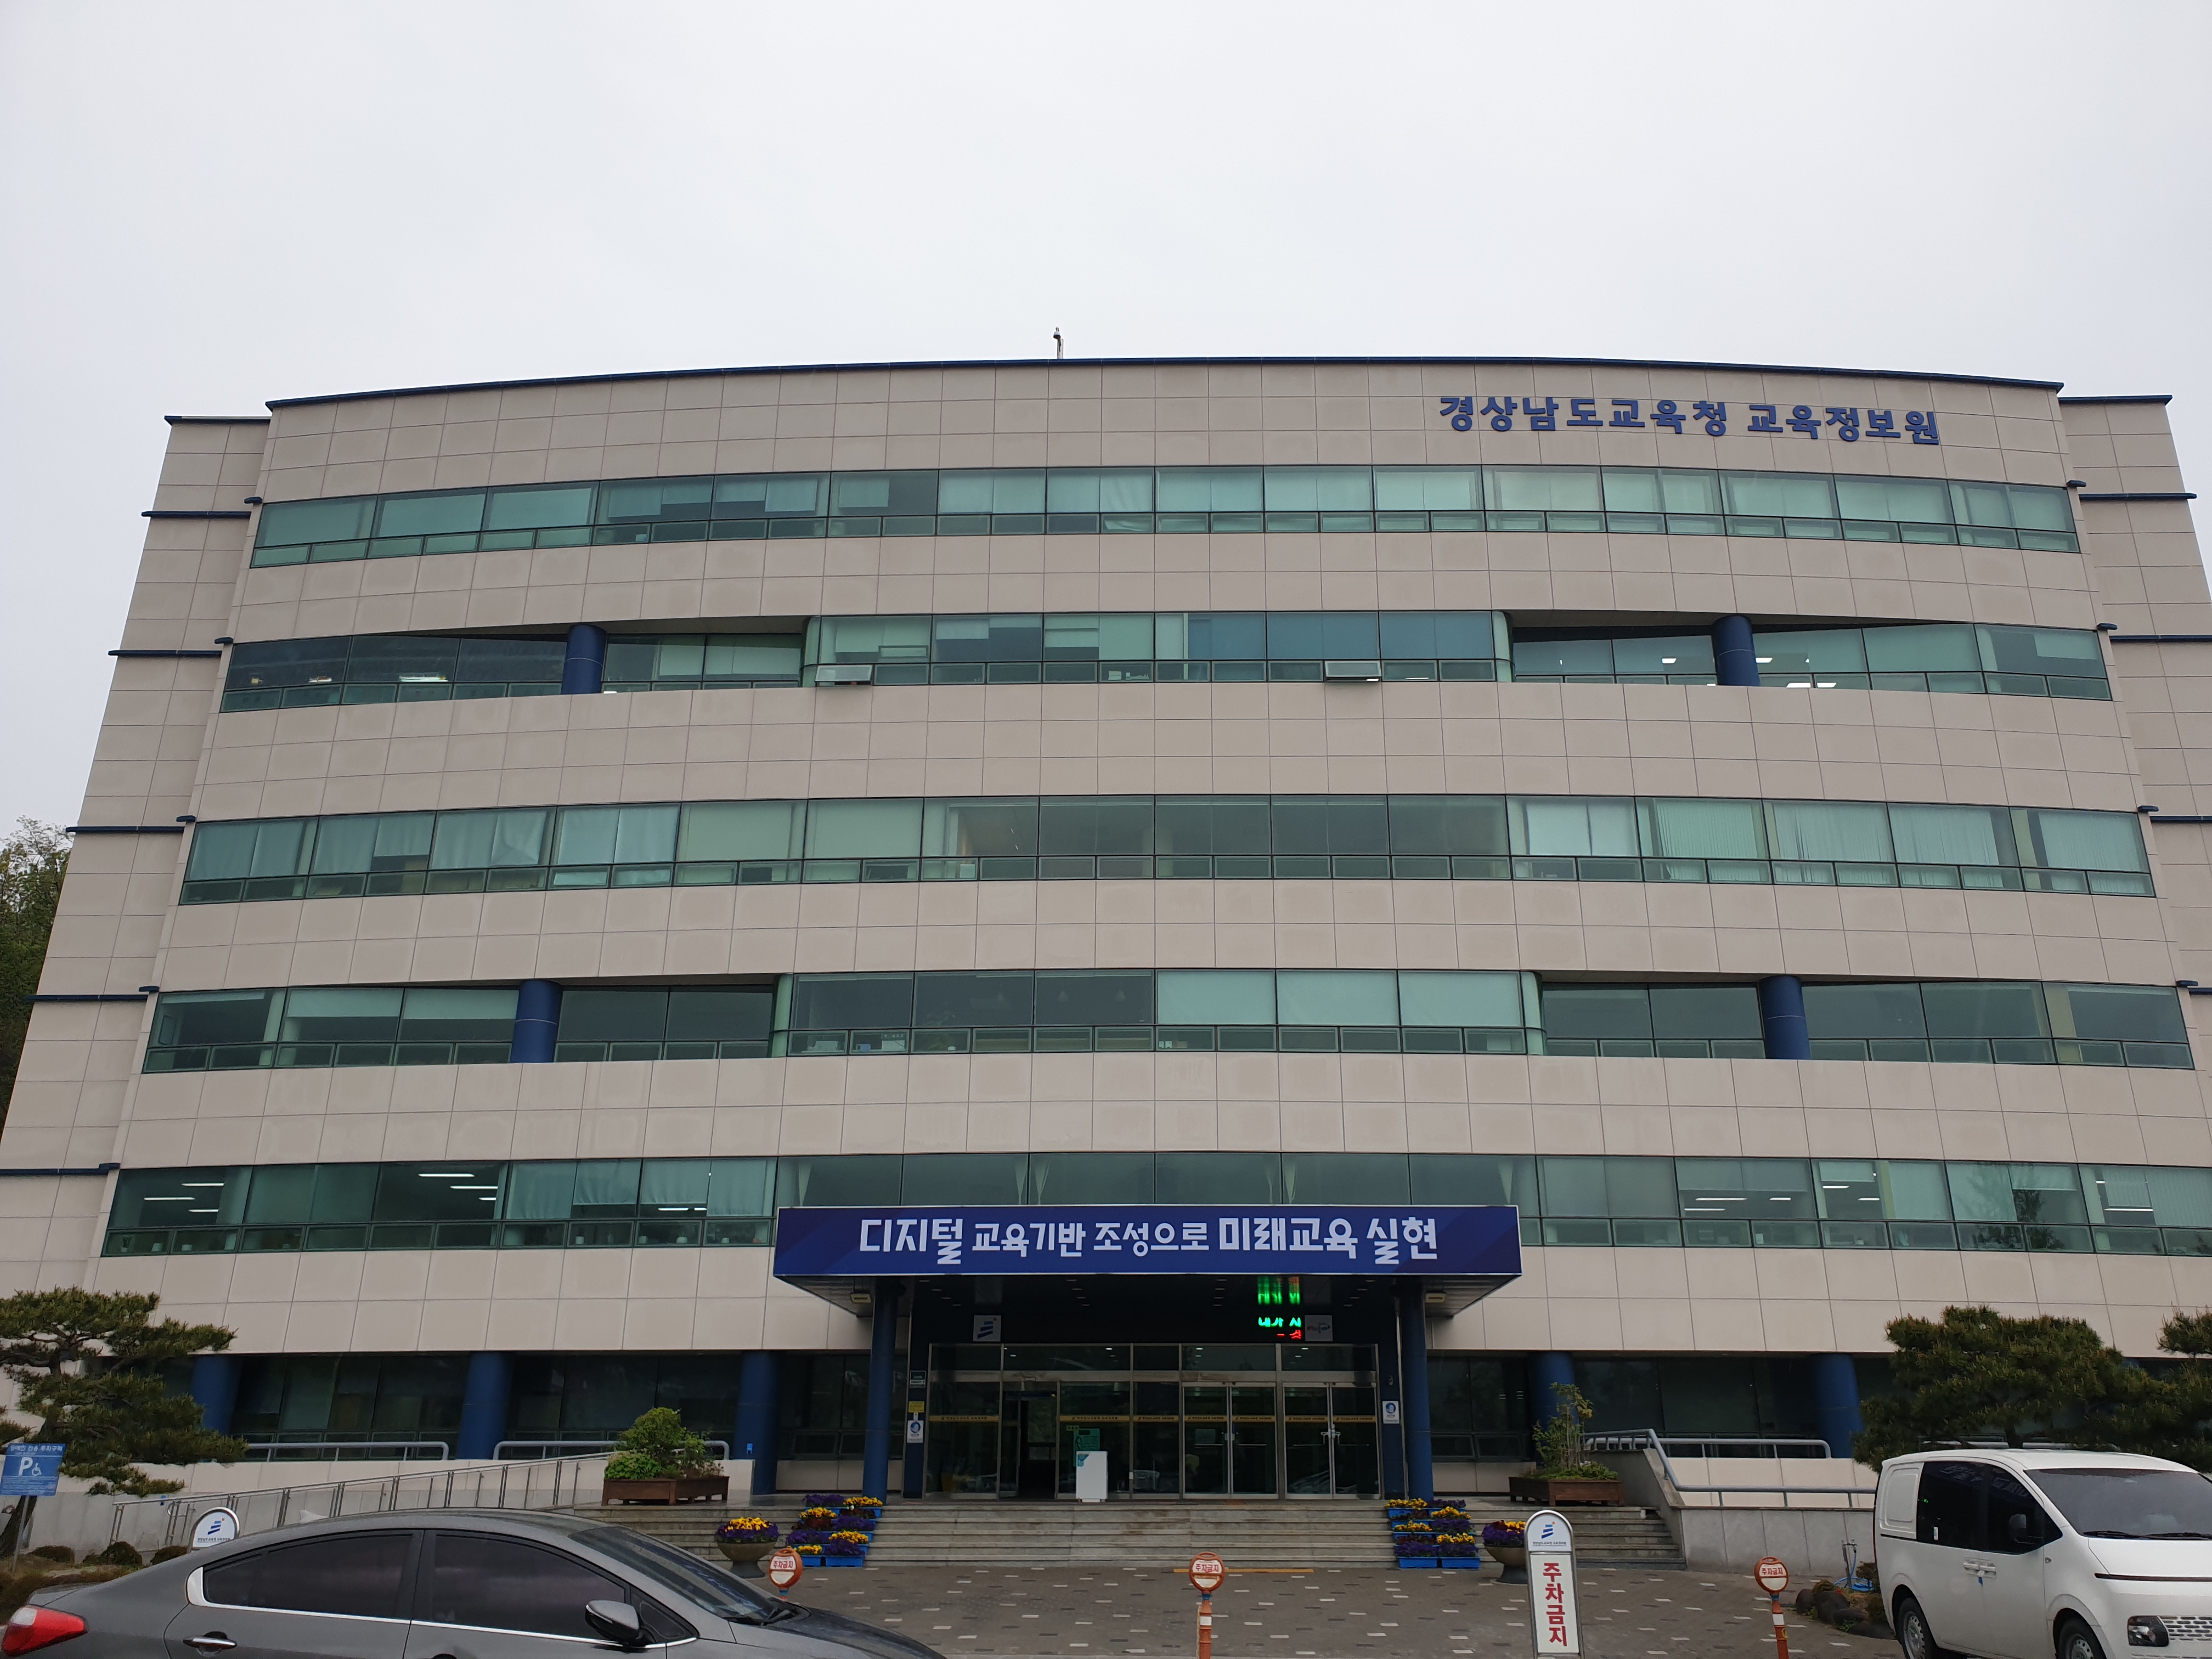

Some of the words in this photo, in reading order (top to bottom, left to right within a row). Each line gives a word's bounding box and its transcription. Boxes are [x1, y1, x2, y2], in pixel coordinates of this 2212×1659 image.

[1440, 396, 1728, 436] 경상남도교육청
[1748, 404, 1940, 445] 교육정보원
[860, 1218, 963, 1264] 디지털
[972, 1223, 1086, 1257] 교육기반
[1093, 1223, 1209, 1257] 조성으로
[1219, 1218, 1358, 1259] 미래교육
[1367, 1217, 1437, 1264] 실현
[18, 1457, 33, 1476] P
[1195, 1564, 1219, 1572] 주차금지
[1543, 1562, 1567, 1646] 주차금지
